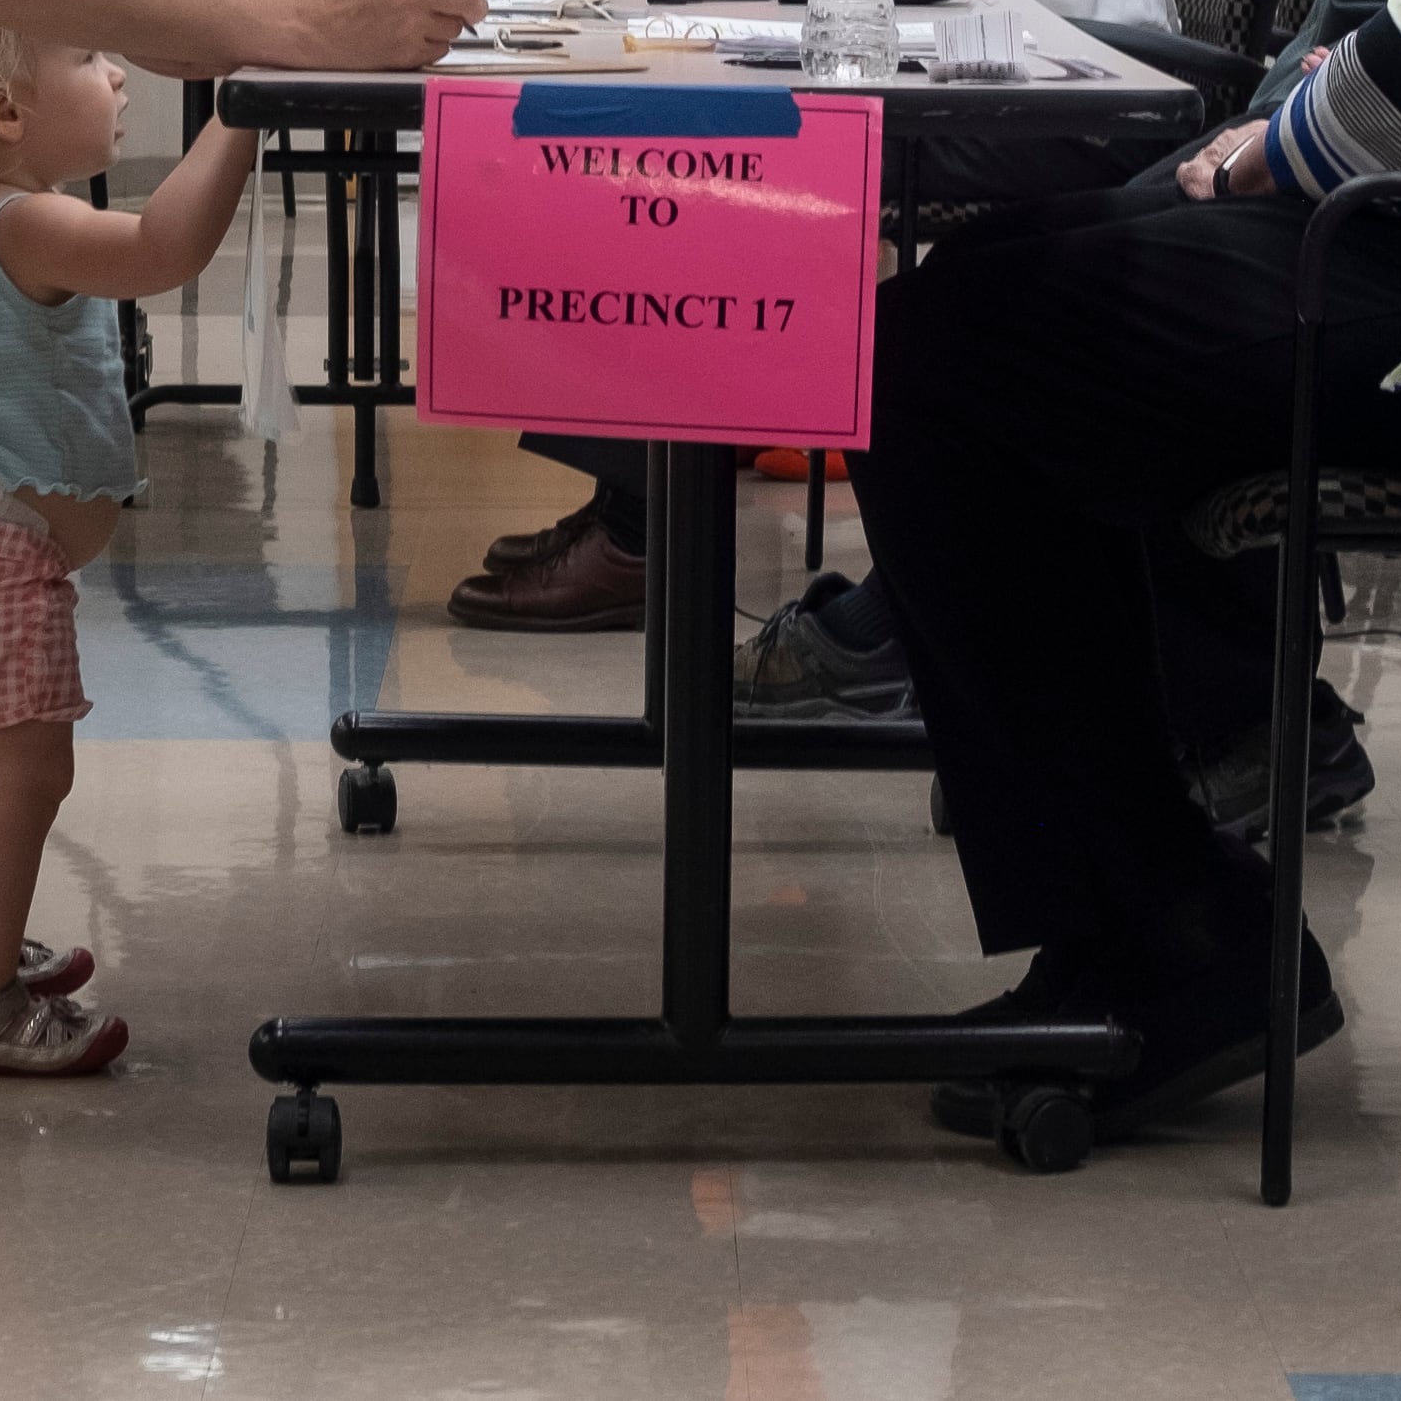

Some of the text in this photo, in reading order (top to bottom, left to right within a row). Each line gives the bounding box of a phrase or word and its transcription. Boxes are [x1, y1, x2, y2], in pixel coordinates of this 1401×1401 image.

[540, 144, 764, 182] WELCOME
[621, 195, 679, 228] TO
[498, 287, 795, 333] PRECINCT 17
